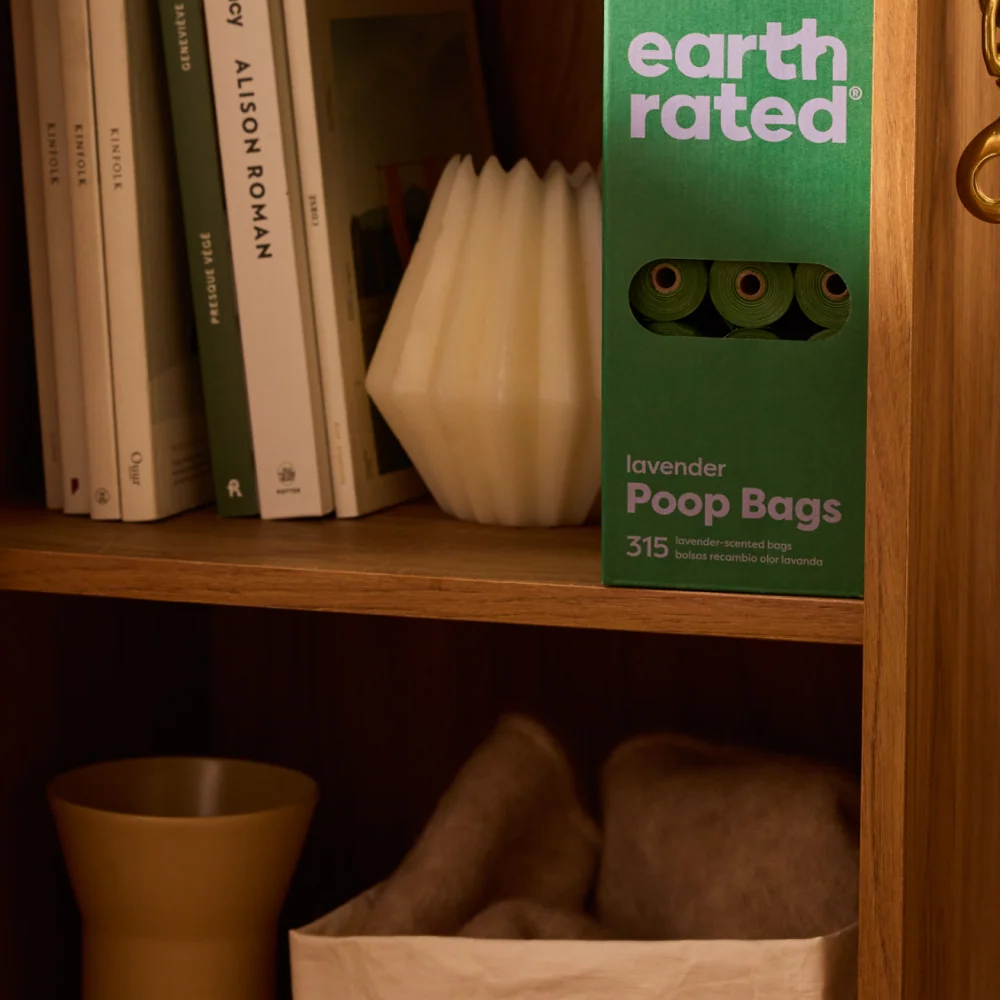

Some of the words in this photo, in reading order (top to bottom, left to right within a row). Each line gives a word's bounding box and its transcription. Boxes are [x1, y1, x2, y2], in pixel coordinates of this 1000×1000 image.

[628, 18, 848, 81] earth
[235, 59, 261, 154] ALISON
[47, 122, 59, 186] KINFOLK
[75, 124, 86, 187] KINFOLK
[110, 128, 122, 191] KINFOLK
[247, 165, 273, 259] ROMAN
[205, 268, 219, 325] PRESQUE
[626, 454, 727, 477] lavender
[627, 482, 730, 526] Poop
[741, 487, 842, 531] Bags
[626, 535, 669, 558] 315
[675, 536, 765, 549] lavender-scented
[767, 540, 792, 553] bags
[675, 550, 707, 560] bolsas
[709, 553, 758, 563] recambio
[760, 554, 779, 564] olor
[781, 556, 823, 567] lavanda
